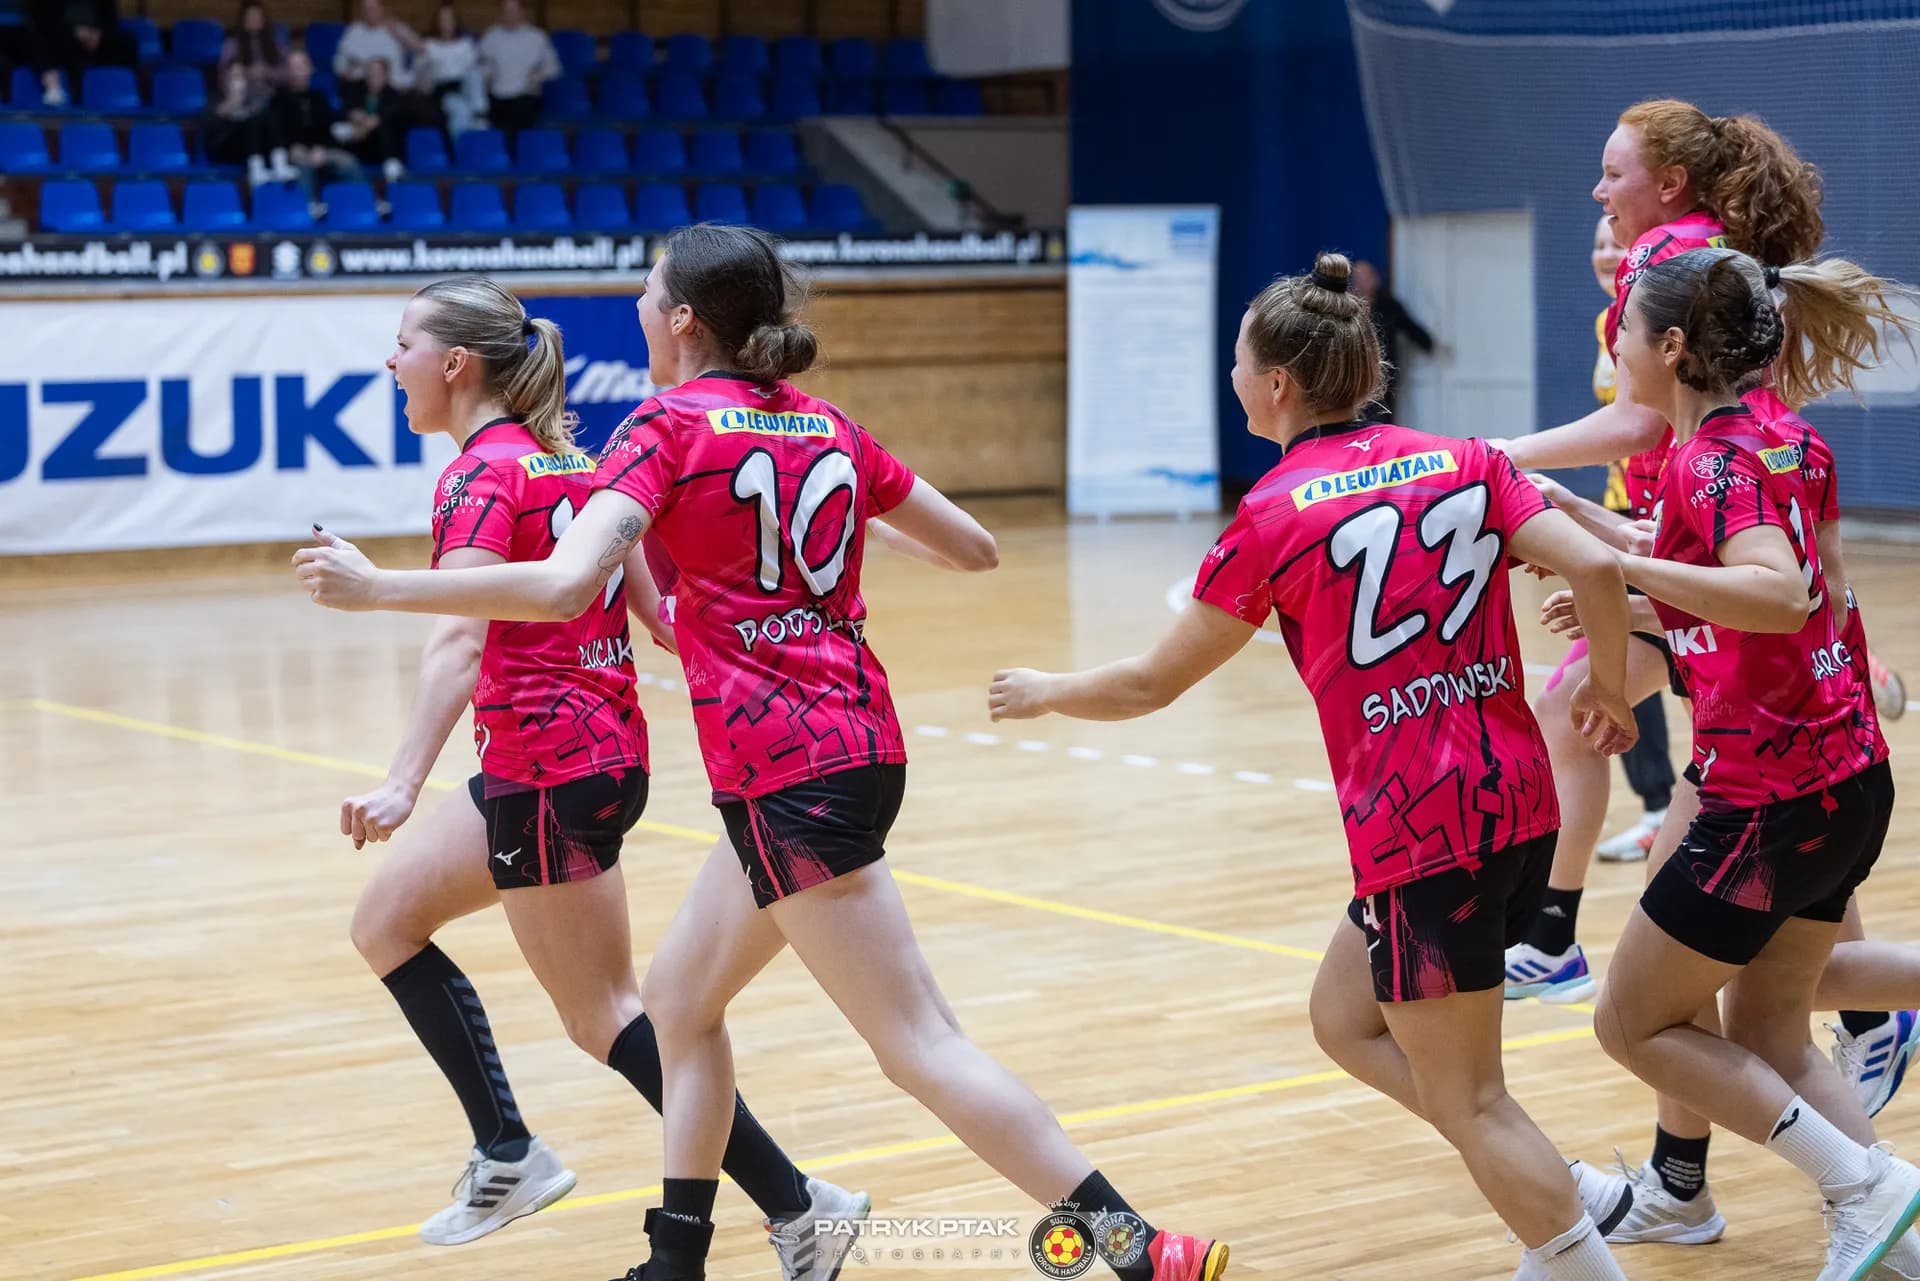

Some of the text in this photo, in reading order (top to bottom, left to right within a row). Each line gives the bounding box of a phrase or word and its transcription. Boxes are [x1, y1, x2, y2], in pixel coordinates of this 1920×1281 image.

[340, 237, 645, 273] www.koronahandball.pl
[748, 410, 830, 435] LEWIATAN
[1334, 453, 1445, 495] LEWIATAN
[1690, 472, 1758, 509] PROFIKA
[1702, 485, 1751, 510] BROKER
[730, 446, 858, 597] 10
[1326, 480, 1504, 670] 23
